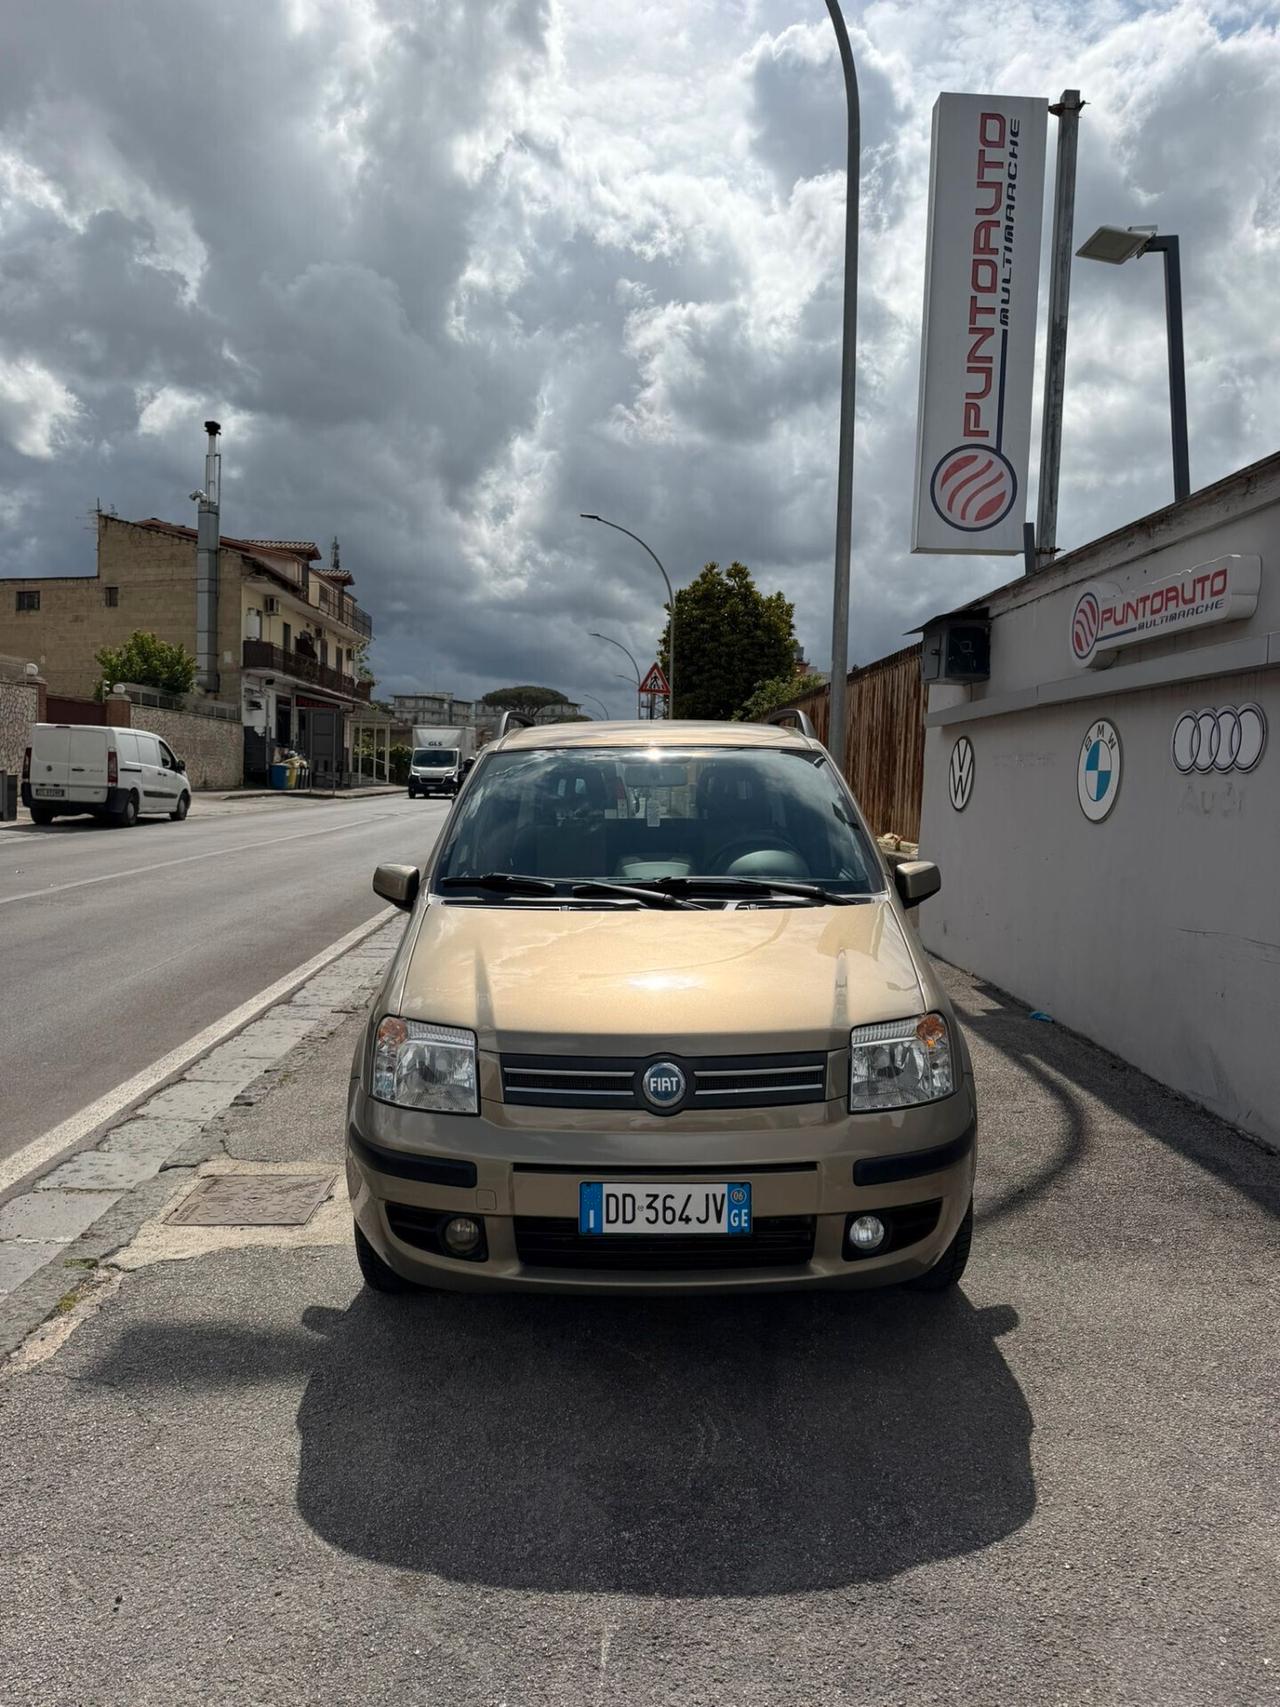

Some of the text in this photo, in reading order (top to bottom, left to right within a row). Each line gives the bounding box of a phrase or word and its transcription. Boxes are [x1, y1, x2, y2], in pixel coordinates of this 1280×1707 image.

[999, 117, 1020, 328] MULTIMARCHE
[962, 112, 1007, 438] PUNTOAUTO
[1100, 568, 1228, 631] PUNTOAUTO
[1137, 598, 1225, 631] MULTIMARCHE
[1084, 724, 1117, 752] BMW
[650, 1077, 679, 1092] FIAT
[730, 1209, 748, 1227] GE
